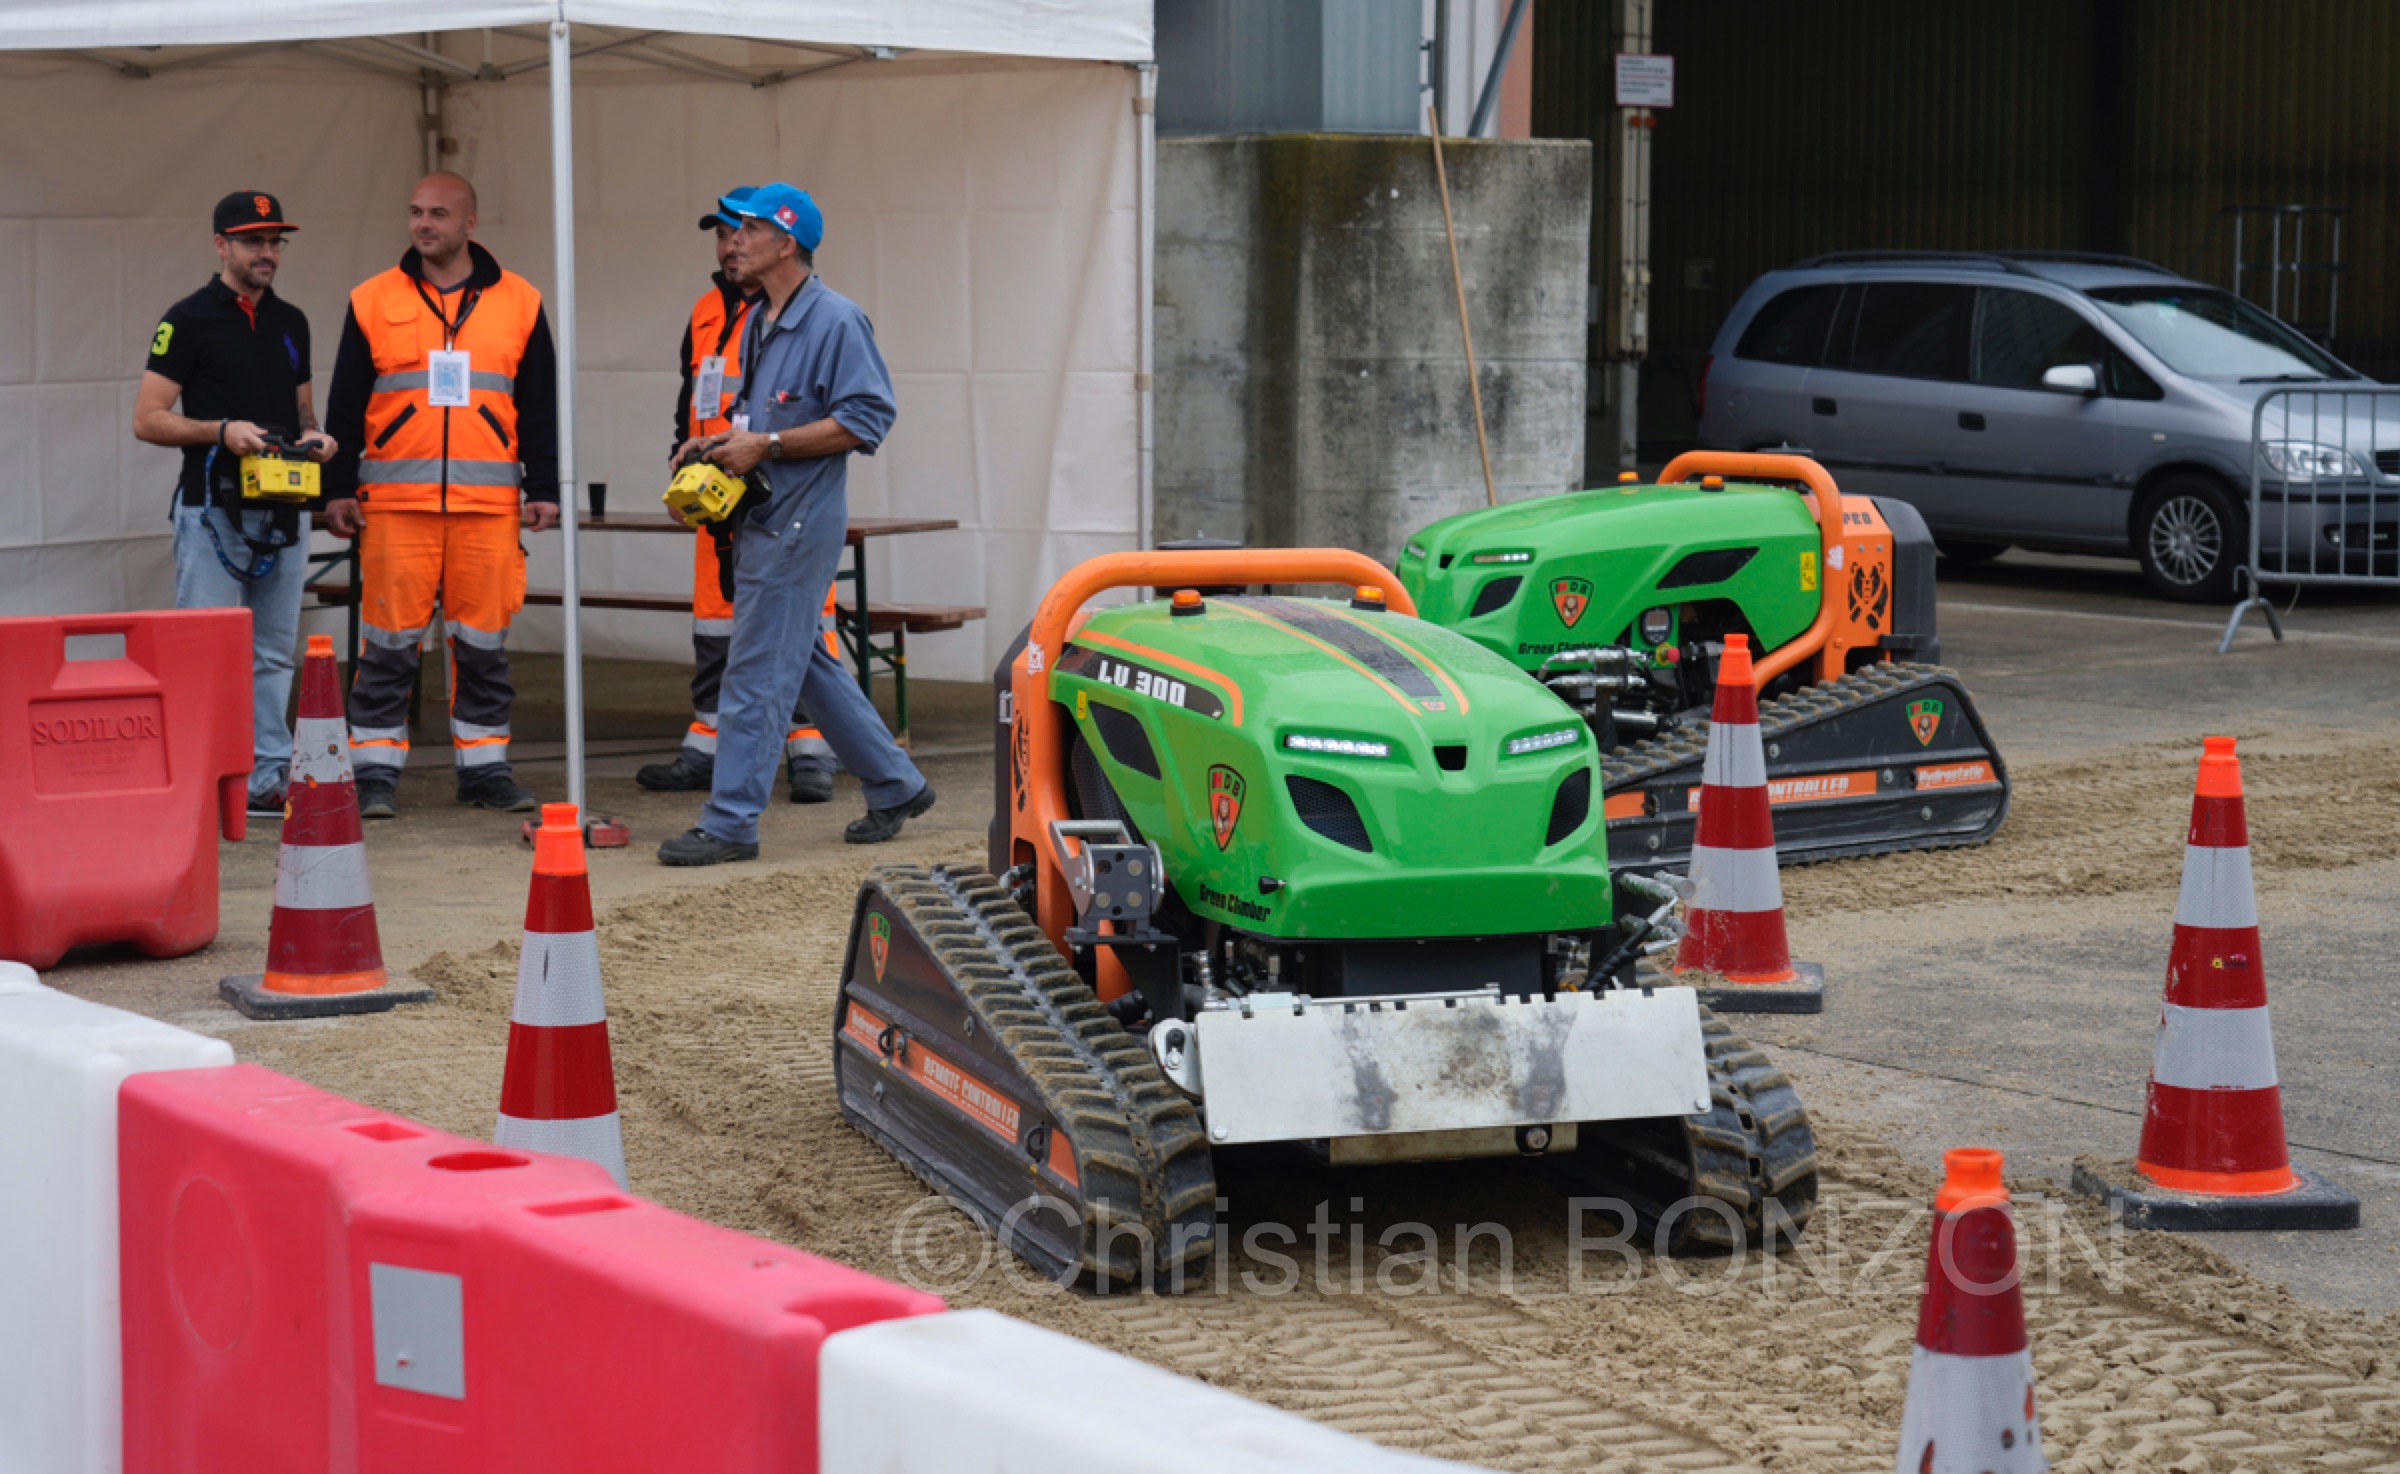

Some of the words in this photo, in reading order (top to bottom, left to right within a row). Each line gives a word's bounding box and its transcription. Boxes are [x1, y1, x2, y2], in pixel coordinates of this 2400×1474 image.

[151, 321, 174, 356] 3
[1134, 669, 1187, 708] 300
[33, 714, 160, 745] SODILOR
[1767, 775, 1849, 796] ONTROLLED
